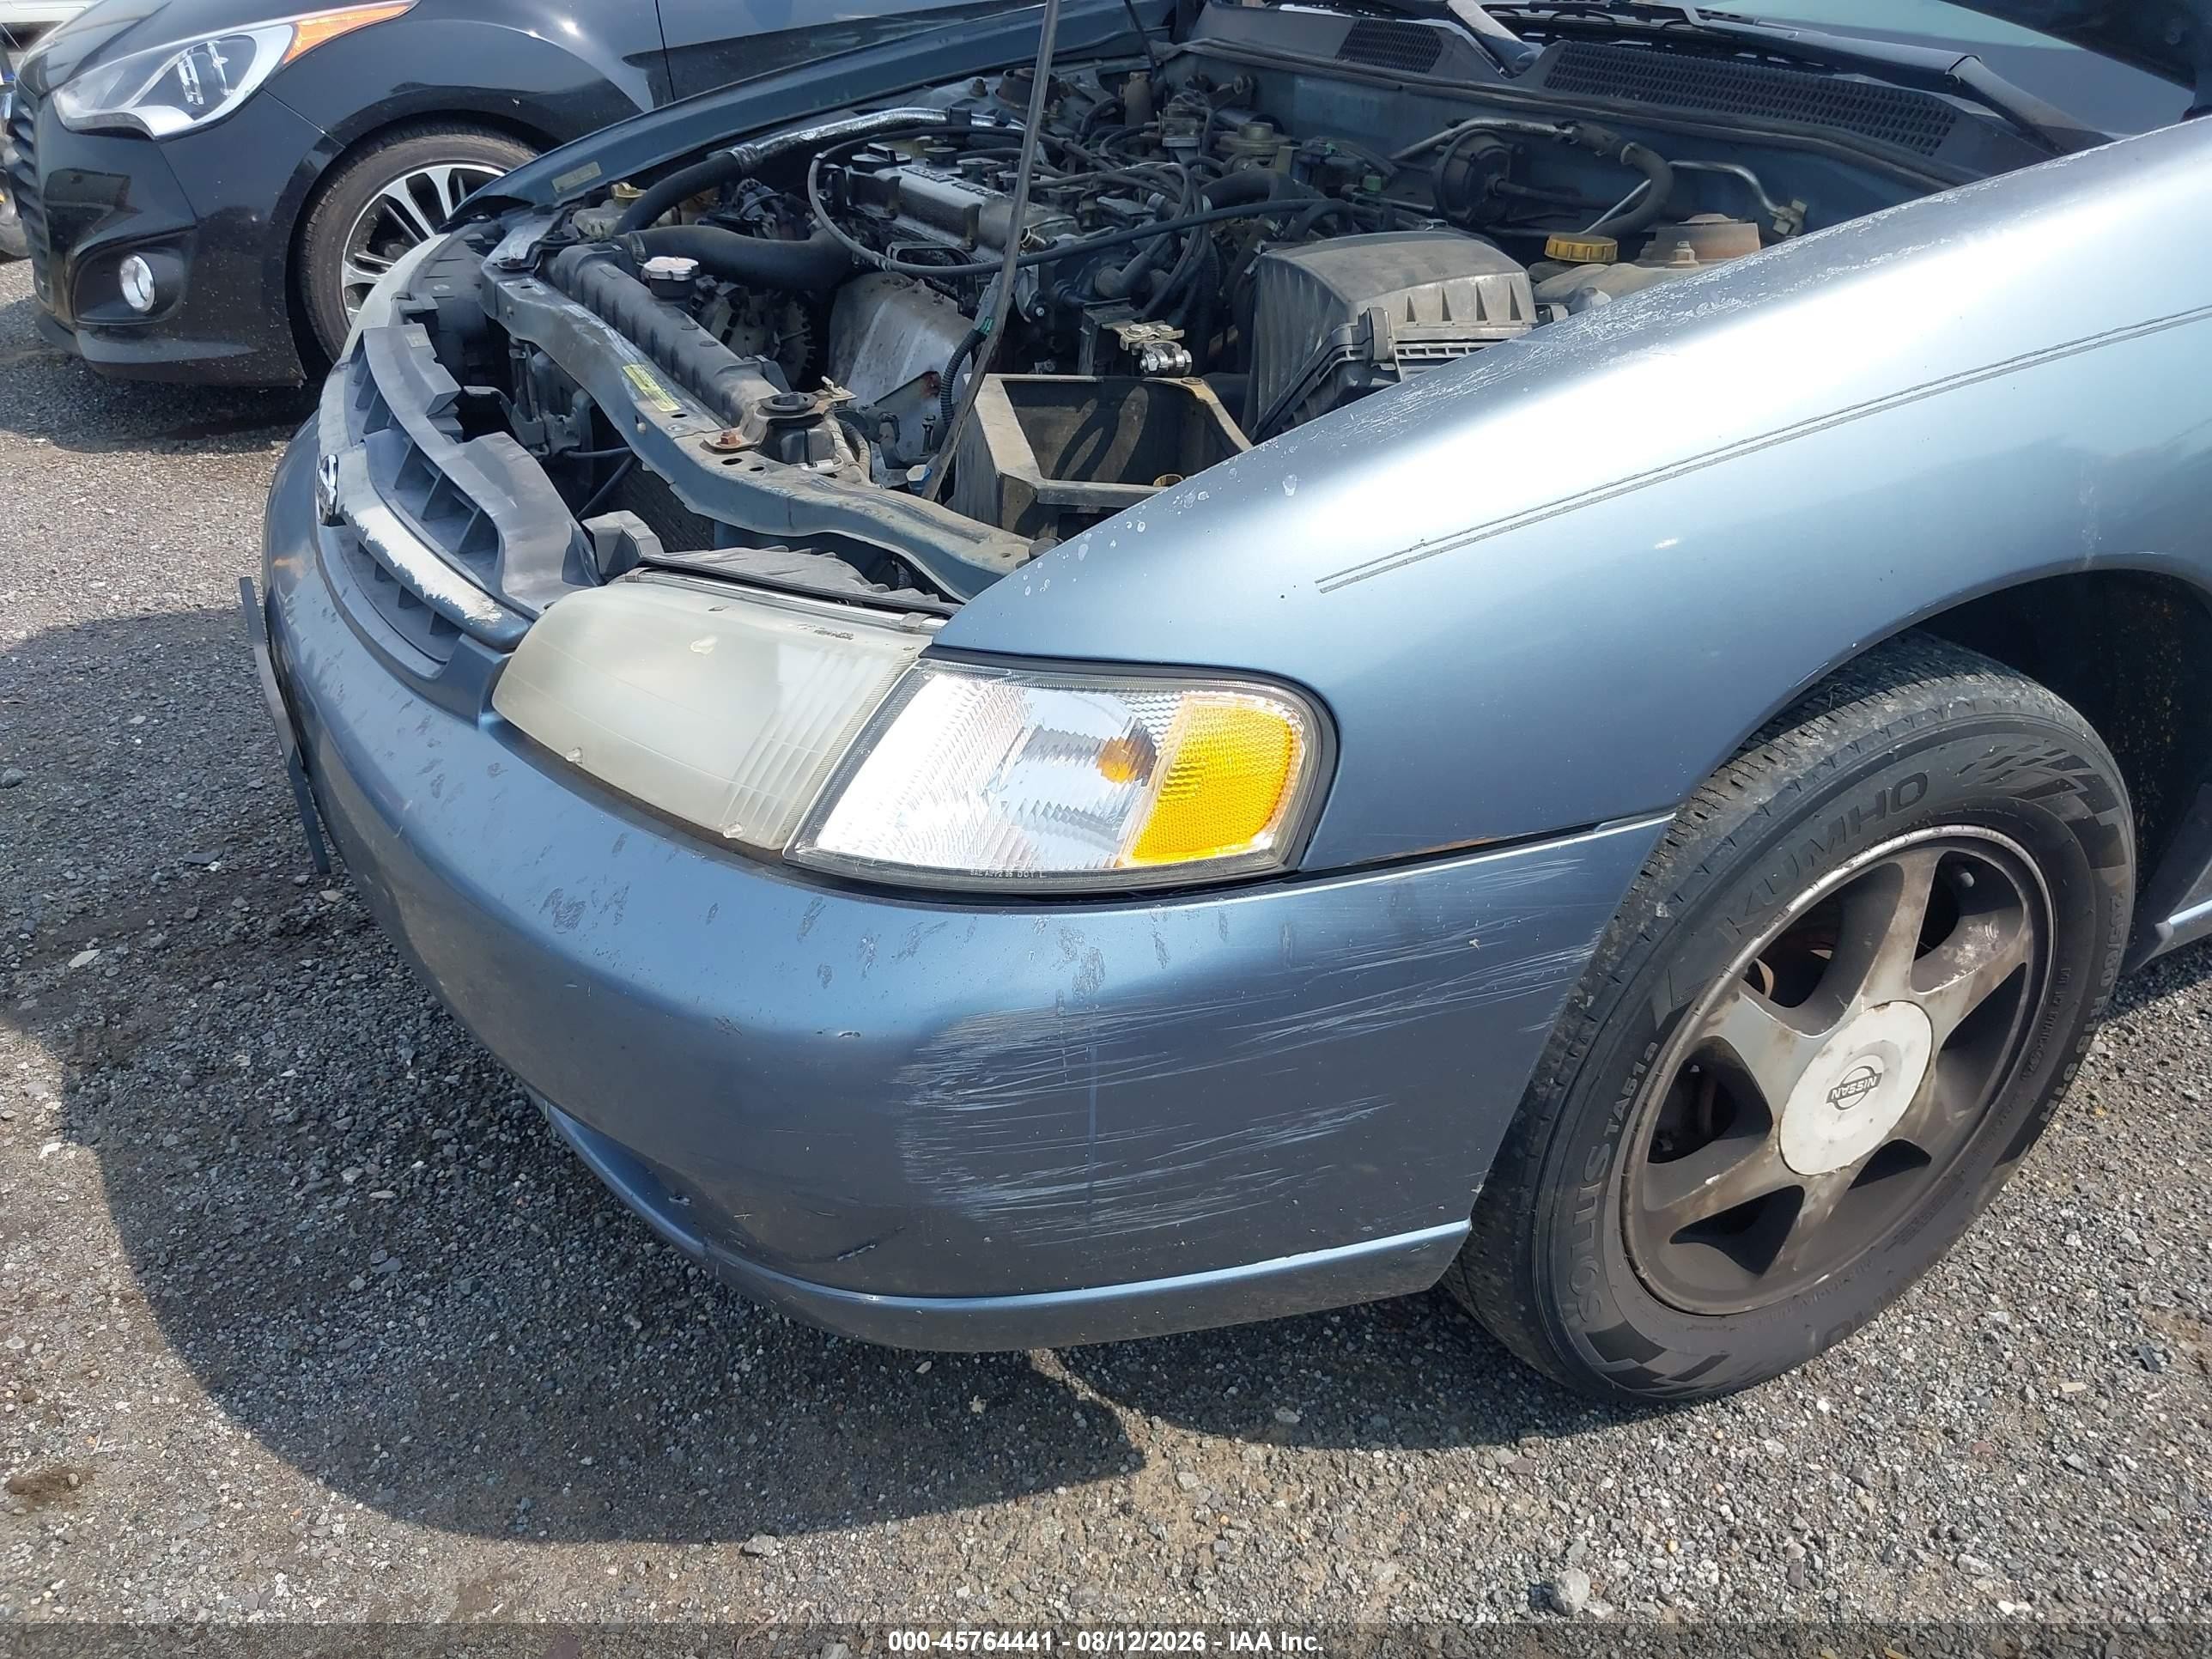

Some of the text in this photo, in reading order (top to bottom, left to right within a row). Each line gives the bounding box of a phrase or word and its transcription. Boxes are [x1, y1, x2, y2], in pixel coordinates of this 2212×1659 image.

[1718, 772, 1929, 945] KUMHO
[2100, 891, 2125, 988] 205/60
[1831, 1076, 1878, 1100] NISSAN
[1569, 1143, 1610, 1323] SOLUS
